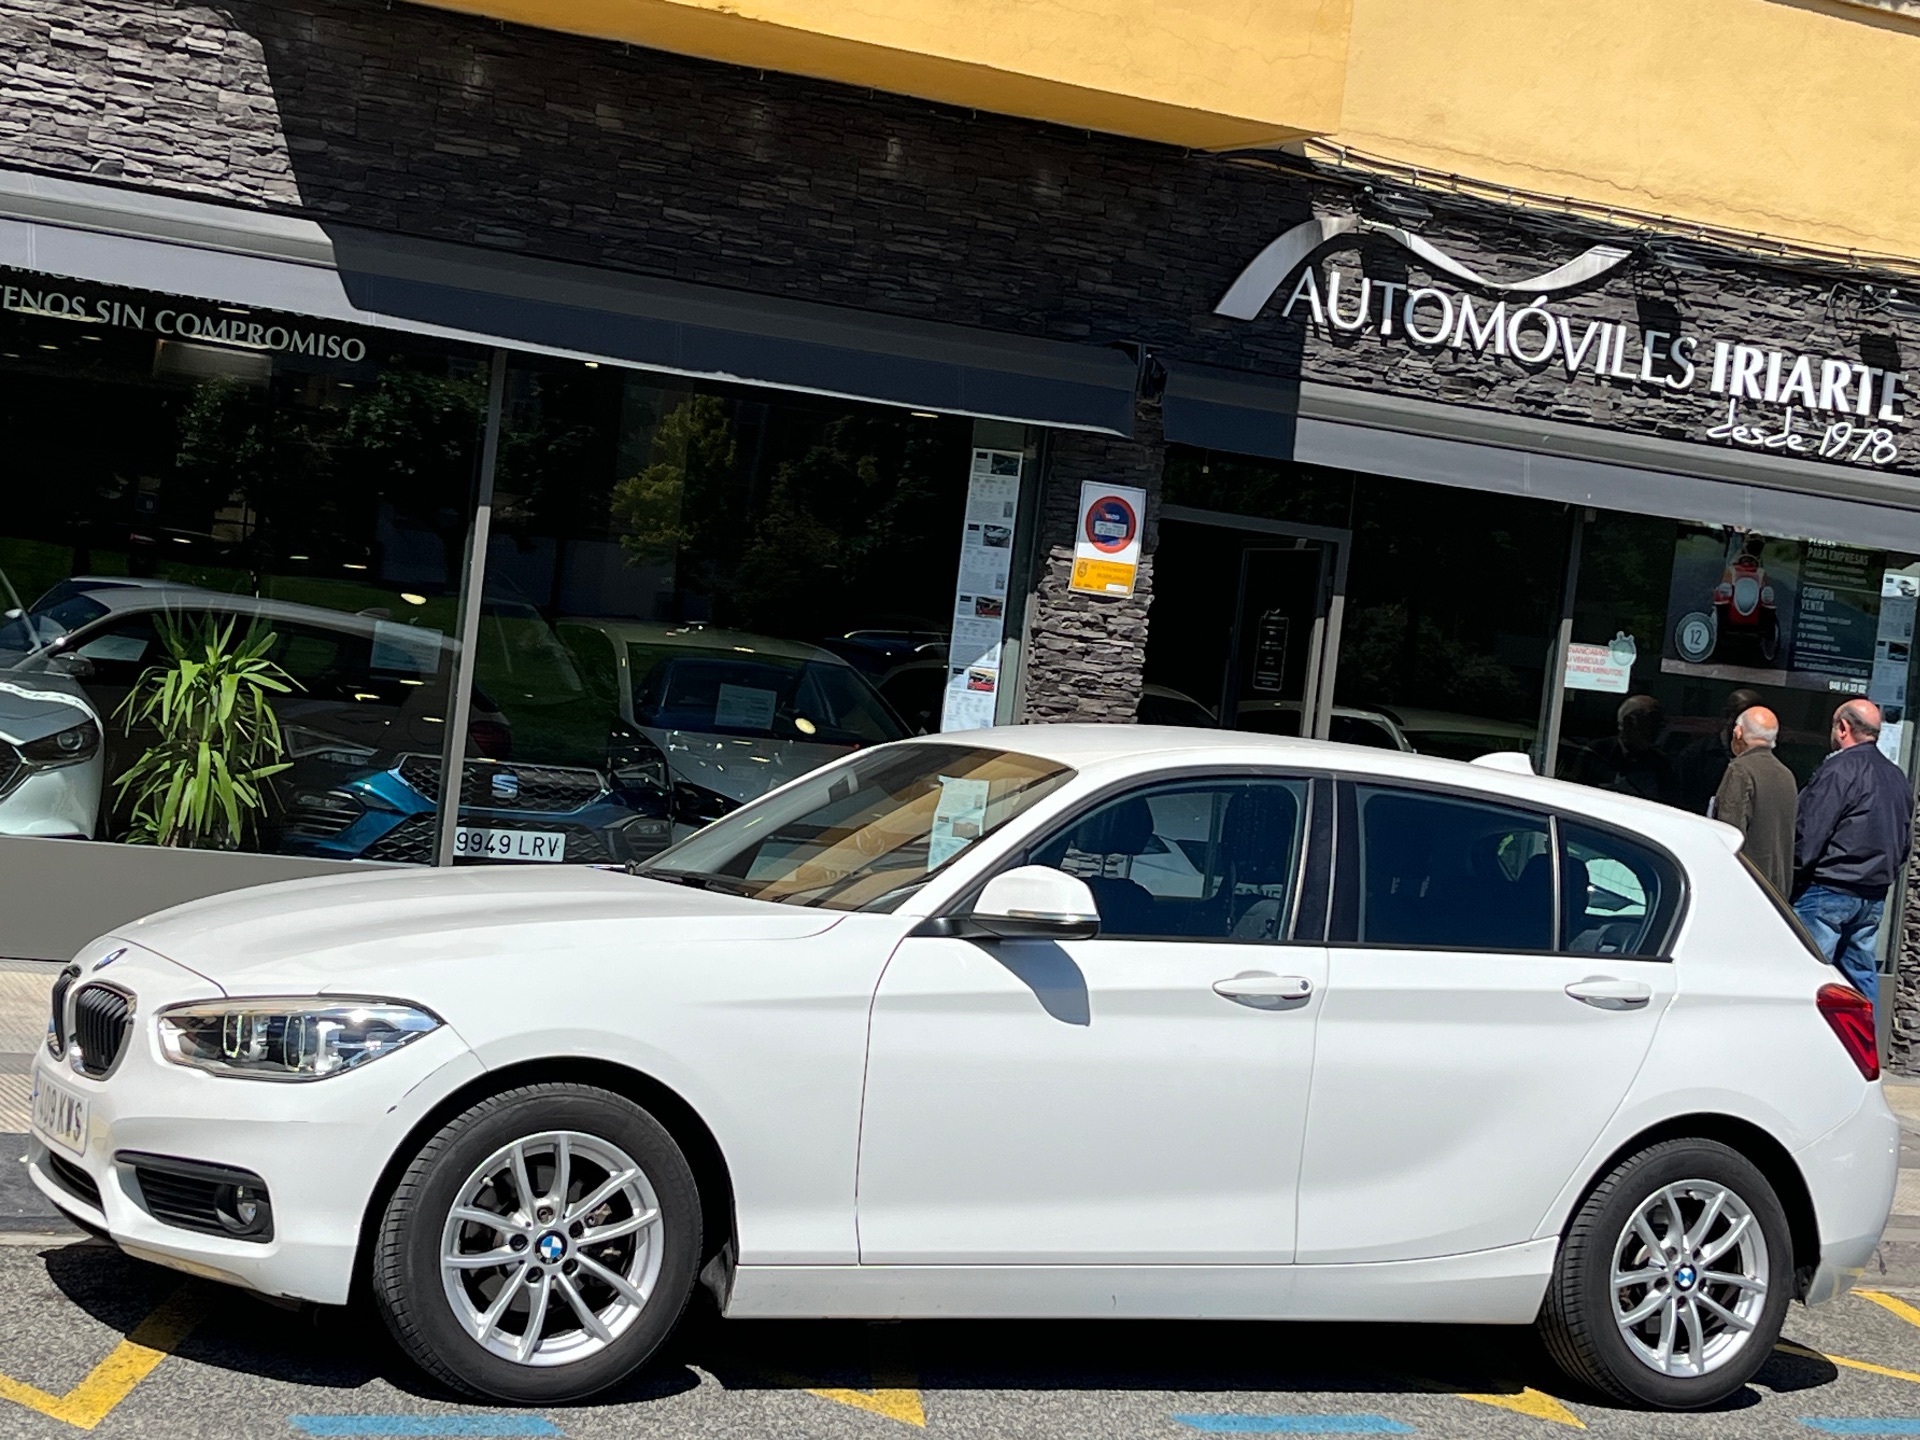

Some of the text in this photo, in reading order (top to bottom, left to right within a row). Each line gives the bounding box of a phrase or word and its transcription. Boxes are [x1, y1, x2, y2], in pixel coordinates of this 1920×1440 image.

[0, 284, 86, 319] ENOS
[96, 299, 145, 330] SIN
[155, 309, 366, 362] COMPROMISO
[1282, 265, 1909, 423] AUTOMÓVILES IRIARTE
[1706, 398, 1898, 464] desde 1978
[1801, 598, 1825, 612] VENTA
[1802, 586, 1834, 601] COMPRA
[1690, 629, 1702, 645] 12
[456, 832, 559, 857] 9949 LRV
